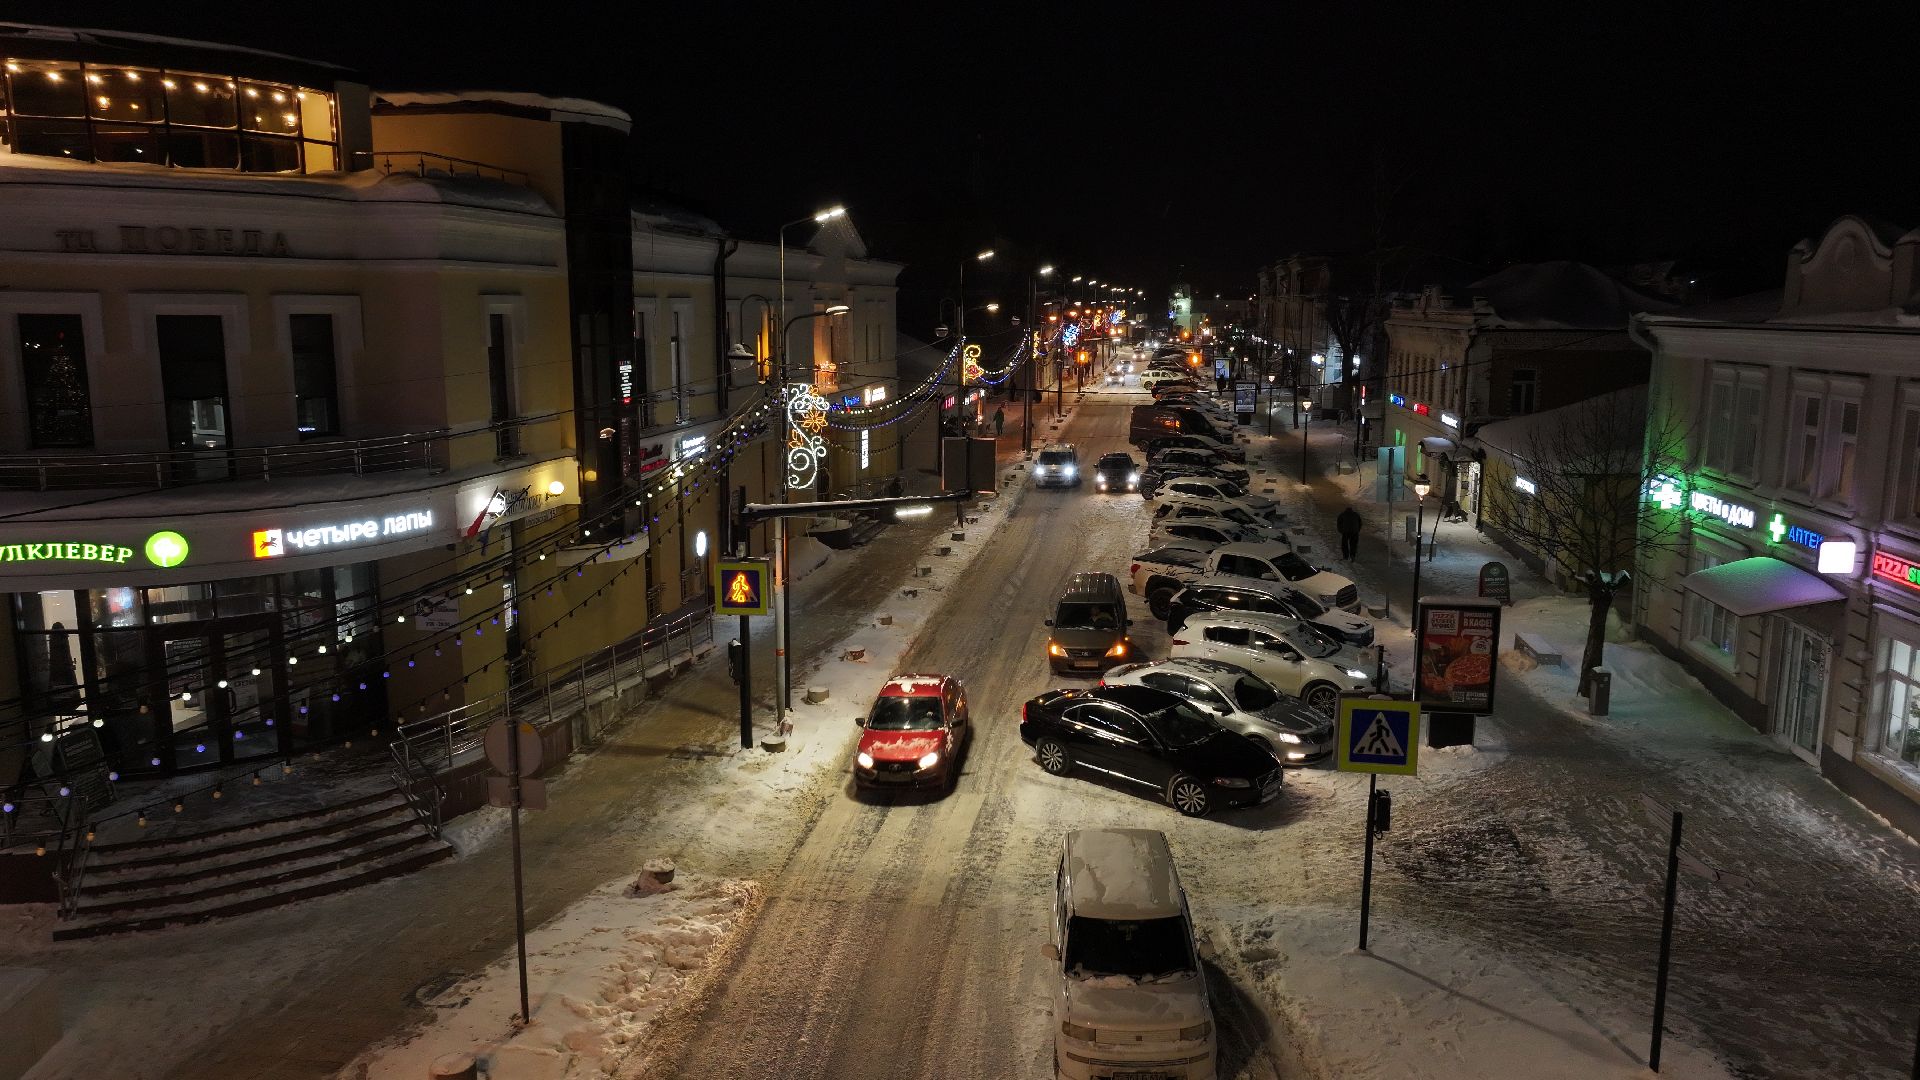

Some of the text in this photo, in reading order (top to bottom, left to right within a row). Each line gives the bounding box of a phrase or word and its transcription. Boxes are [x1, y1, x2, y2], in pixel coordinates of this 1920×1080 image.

[119, 226, 290, 258] ПОБЕДА
[1788, 526, 1824, 549] АПТЕК
[0, 543, 133, 563] ЛКЛЕВЕР
